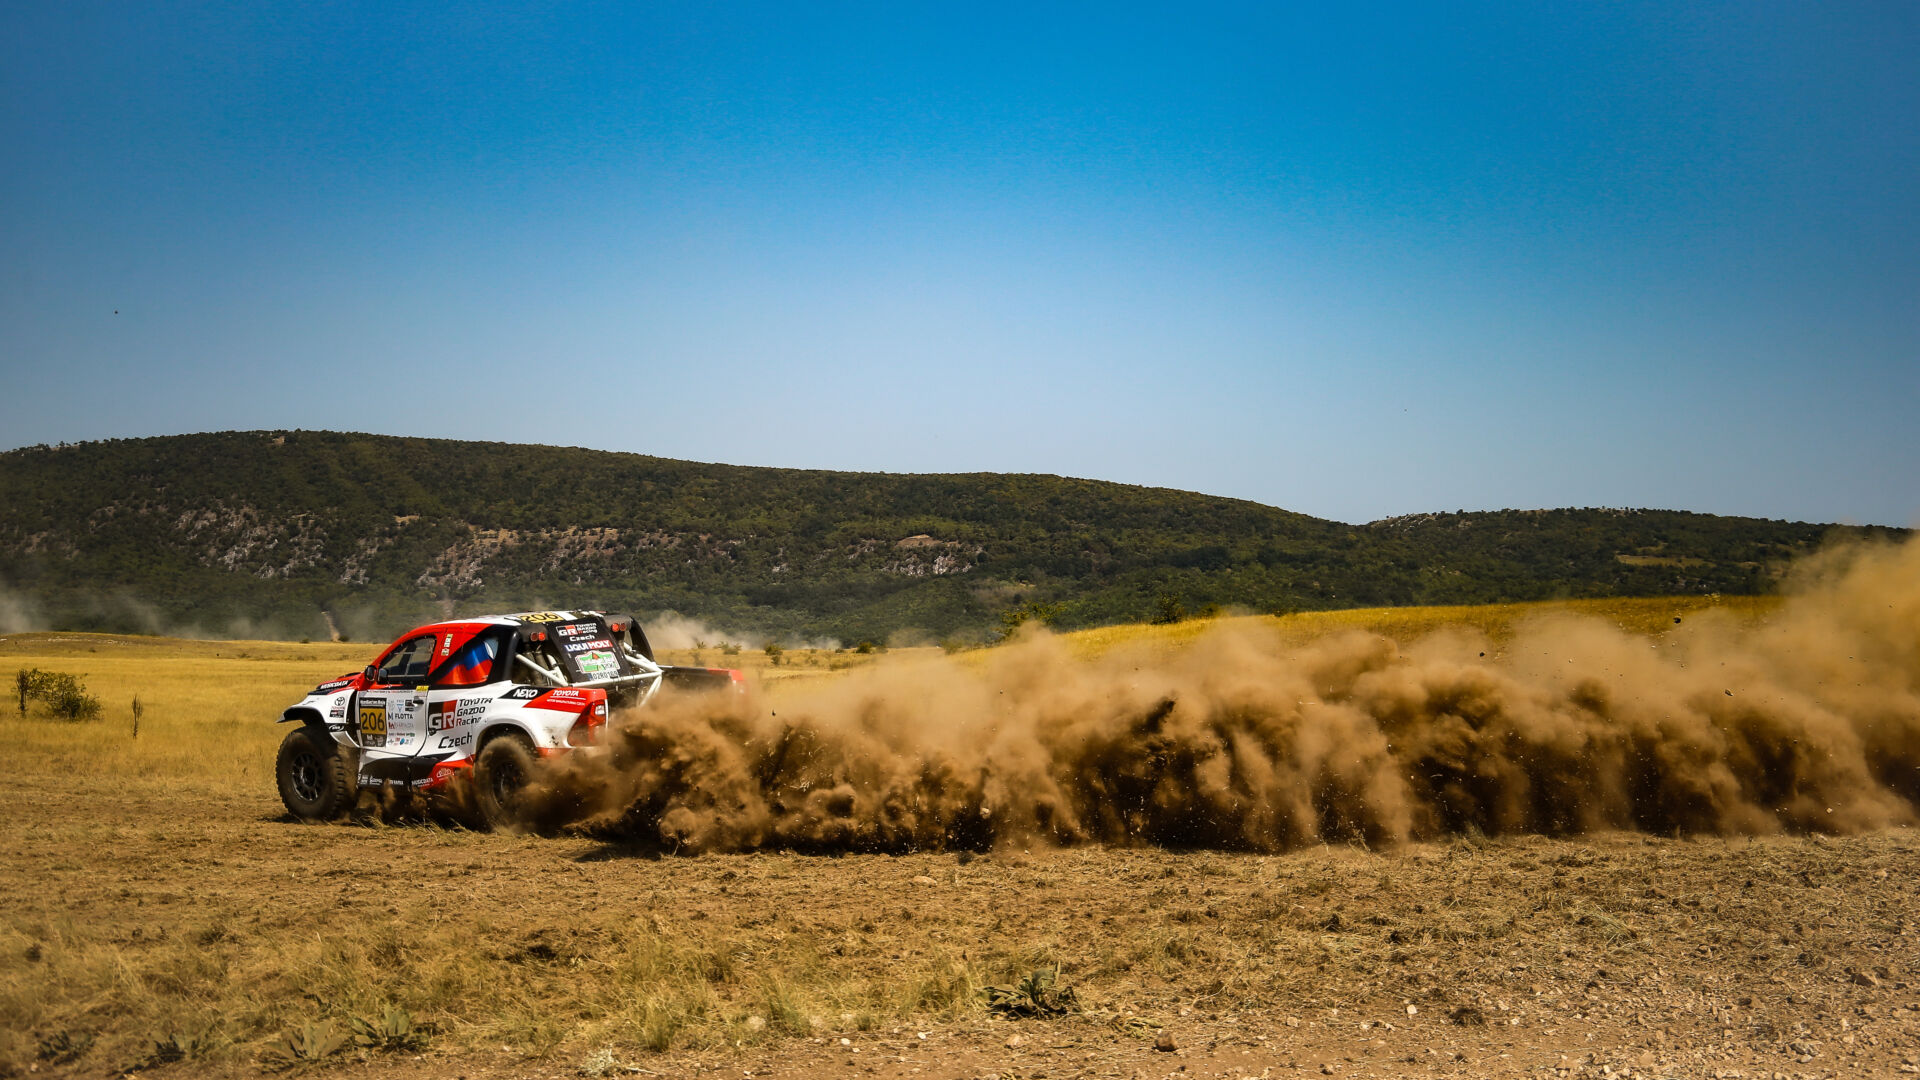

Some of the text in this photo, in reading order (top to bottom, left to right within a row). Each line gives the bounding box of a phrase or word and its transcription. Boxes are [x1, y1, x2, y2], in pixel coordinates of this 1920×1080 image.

[520, 613, 558, 622] 206
[587, 640, 610, 649] MOLY
[513, 688, 538, 698] NEXO
[459, 698, 493, 707] TOYOTA
[457, 706, 486, 717] GAZOO
[361, 712, 385, 731] 206
[429, 711, 454, 729] GR
[438, 731, 473, 749] Czech
